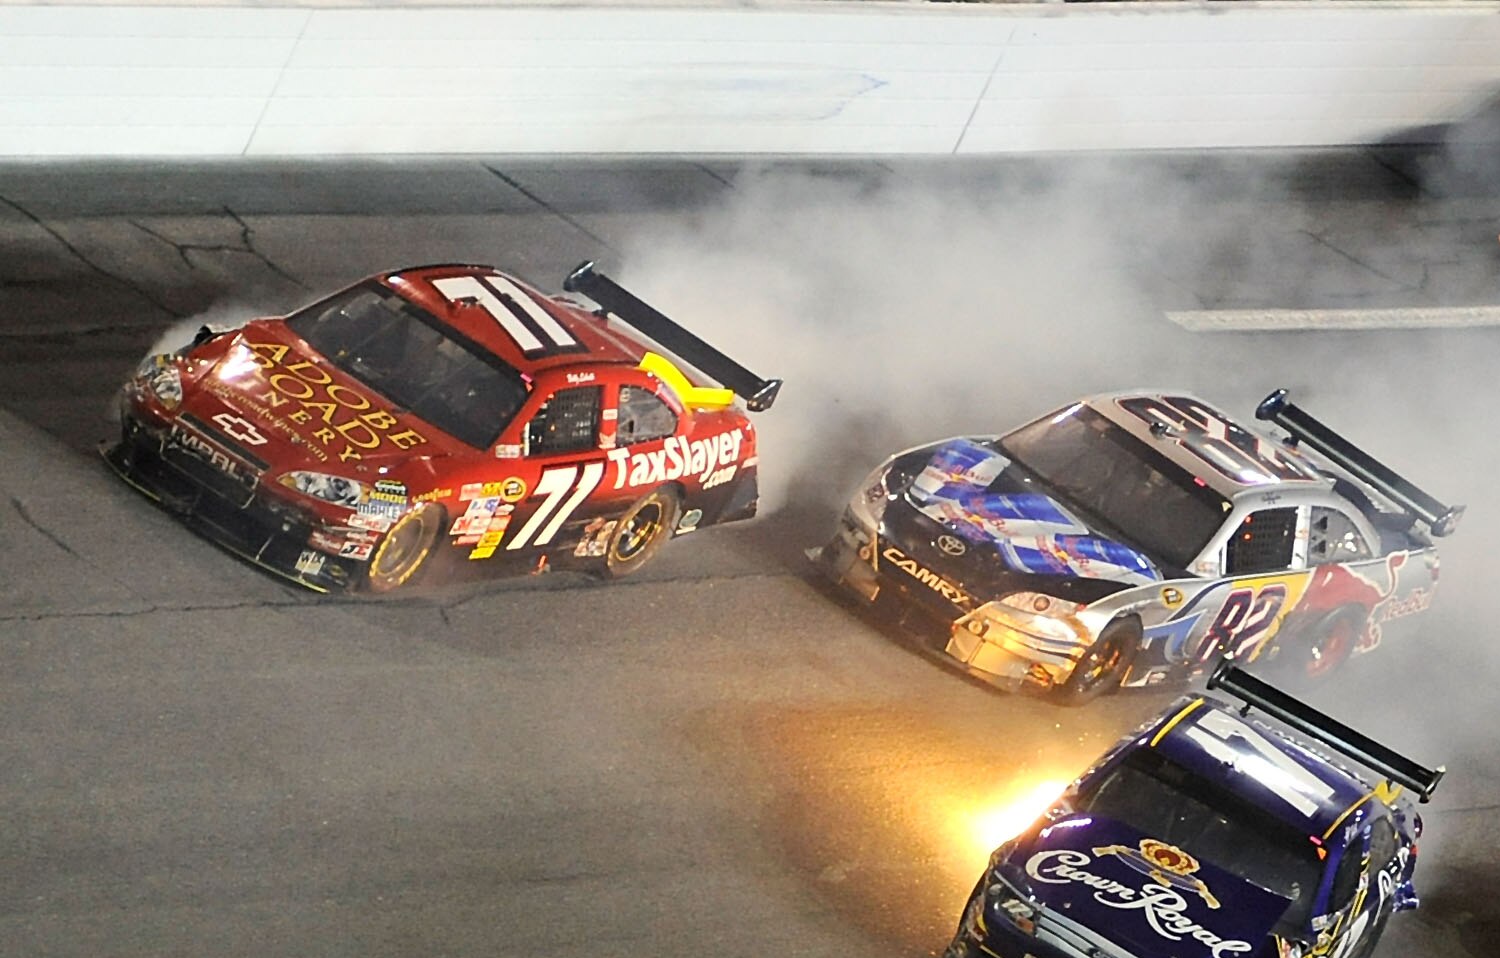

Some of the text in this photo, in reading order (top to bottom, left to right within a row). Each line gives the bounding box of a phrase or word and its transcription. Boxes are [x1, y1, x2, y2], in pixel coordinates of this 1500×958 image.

[431, 274, 577, 352] 71
[250, 341, 429, 452] ADOBE
[607, 429, 744, 490] TaxSlayer
[506, 462, 606, 552] 71
[882, 547, 971, 604] CAMRY
[1196, 585, 1290, 664] 82
[1025, 849, 1138, 902] Crown
